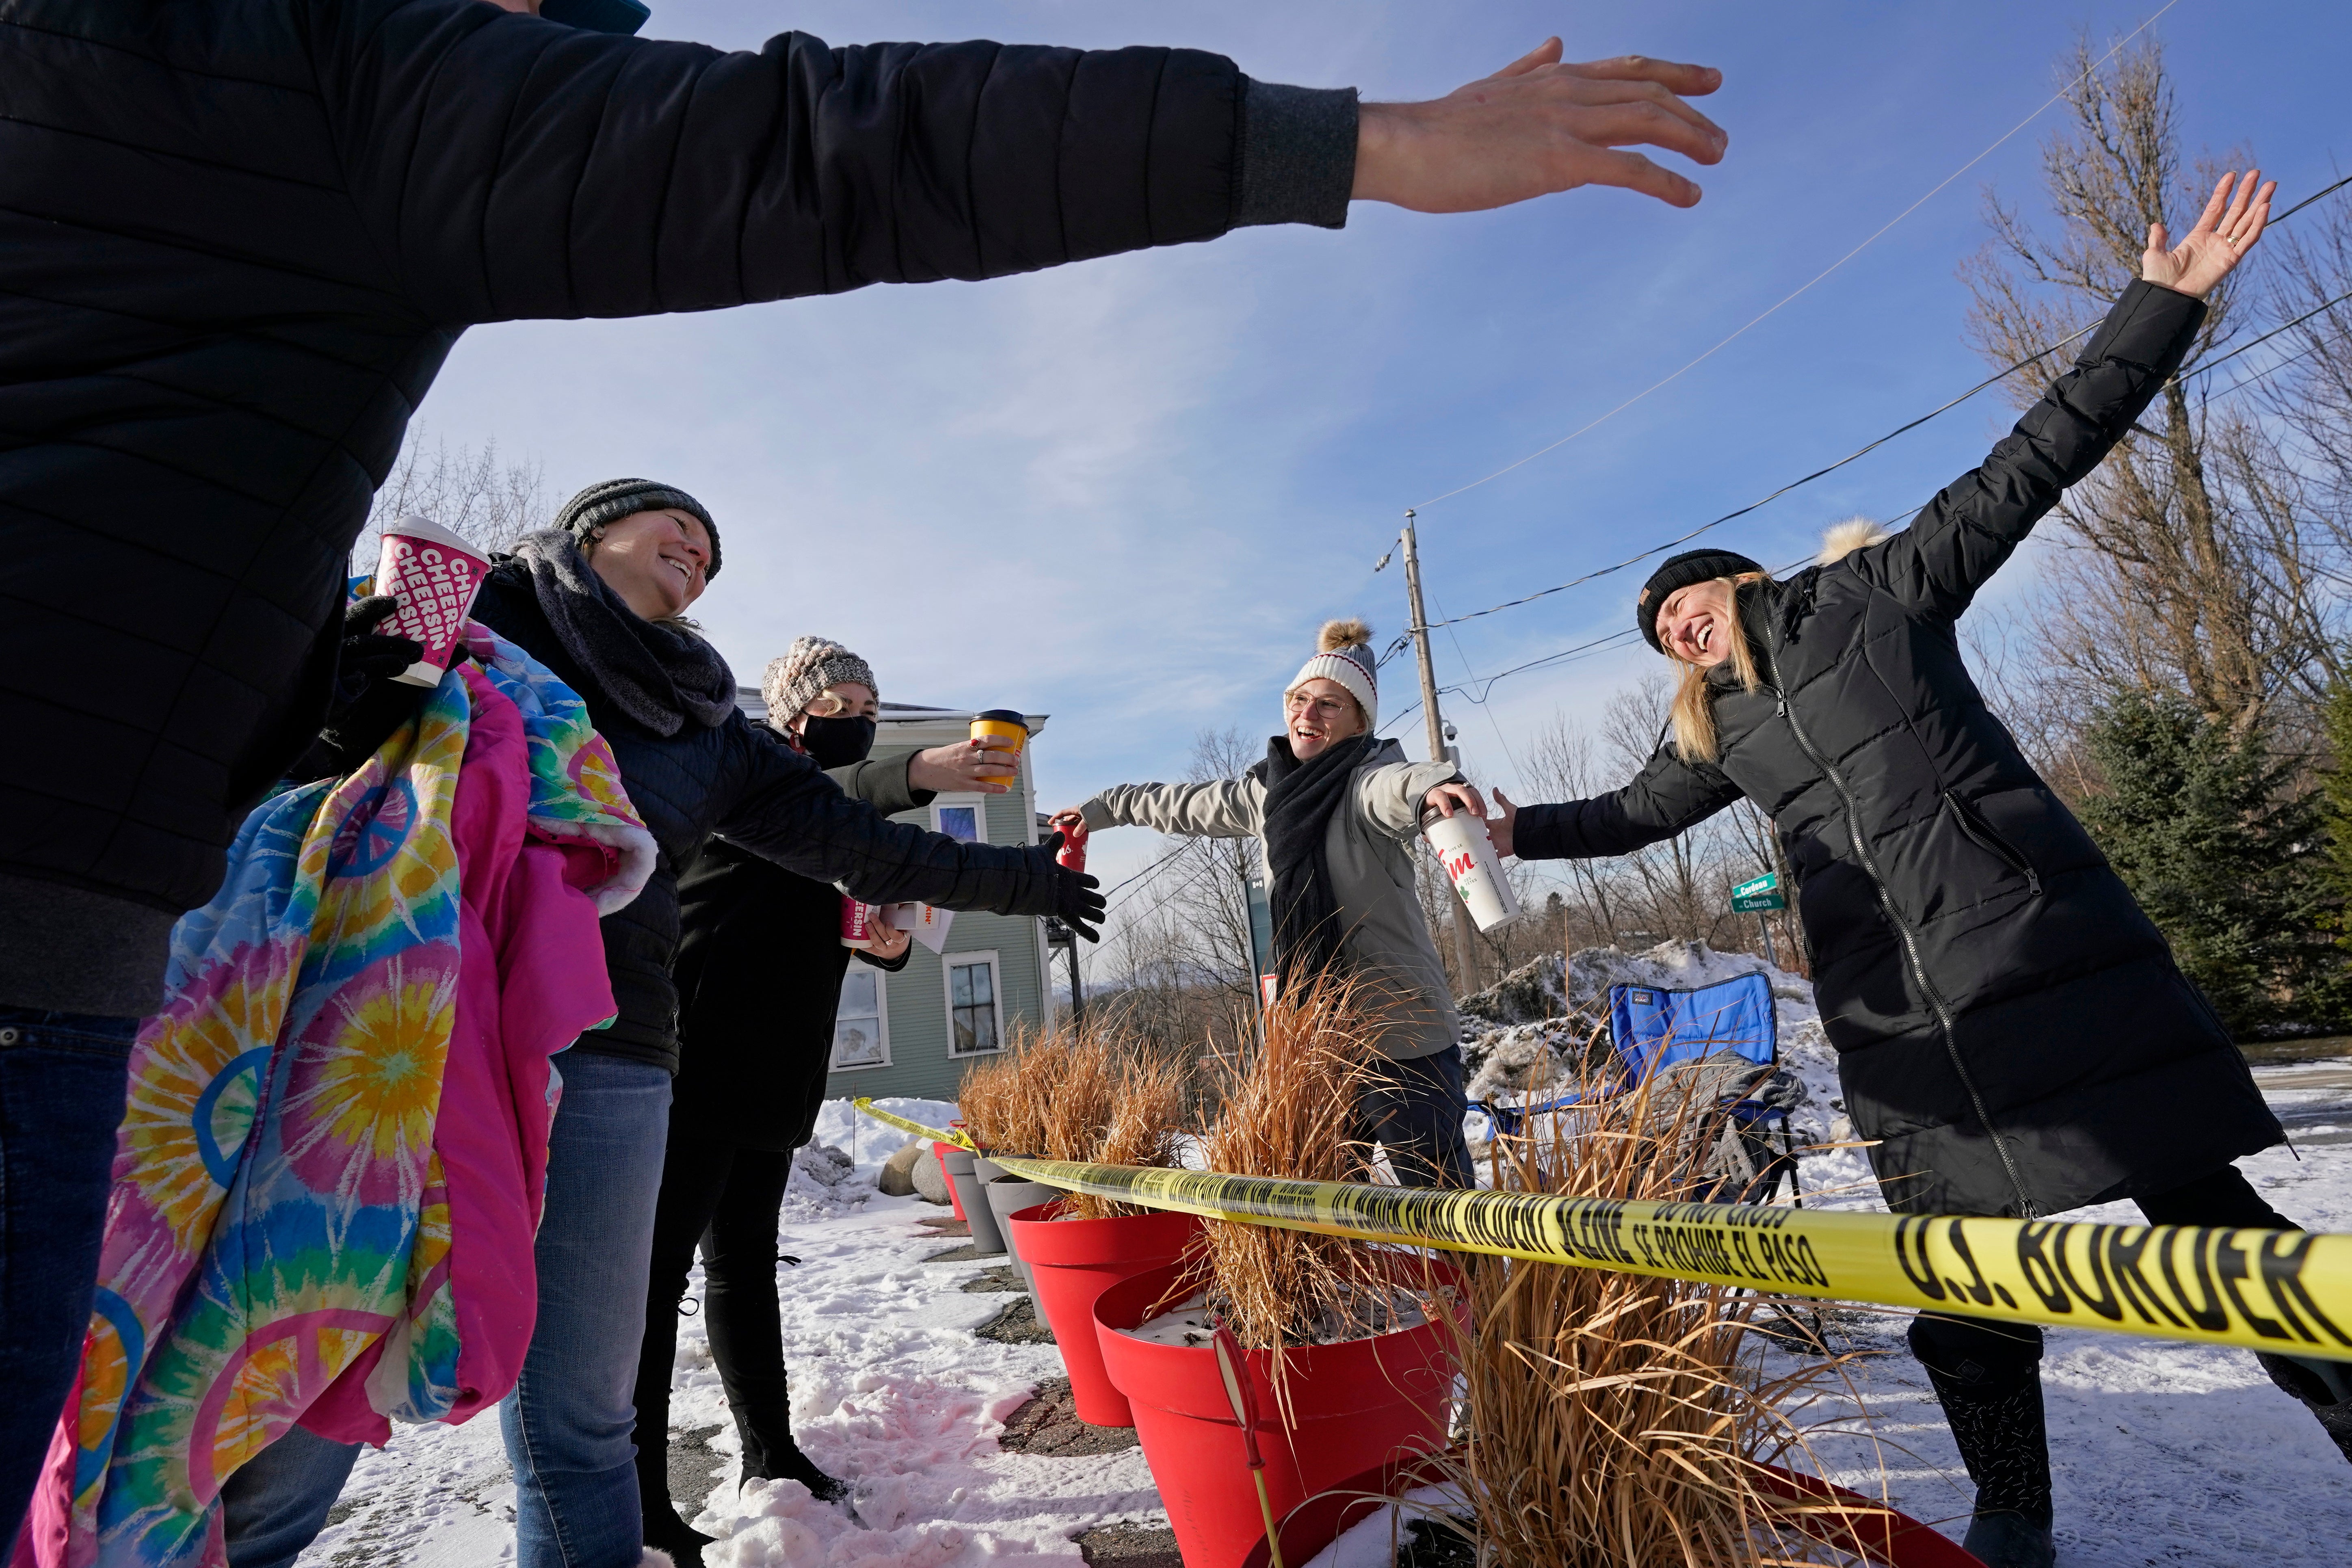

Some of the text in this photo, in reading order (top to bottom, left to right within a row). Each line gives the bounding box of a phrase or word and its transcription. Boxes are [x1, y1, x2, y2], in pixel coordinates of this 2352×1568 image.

[1740, 880, 1768, 896] Cordeau
[1743, 898, 1772, 908] Church
[1303, 1197, 1319, 1224] PASO
[1556, 1197, 1638, 1265] SCENE
[1633, 1223, 1829, 1288] SE PROHIBE EL PASO
[2017, 1221, 2352, 1348] BORDER
